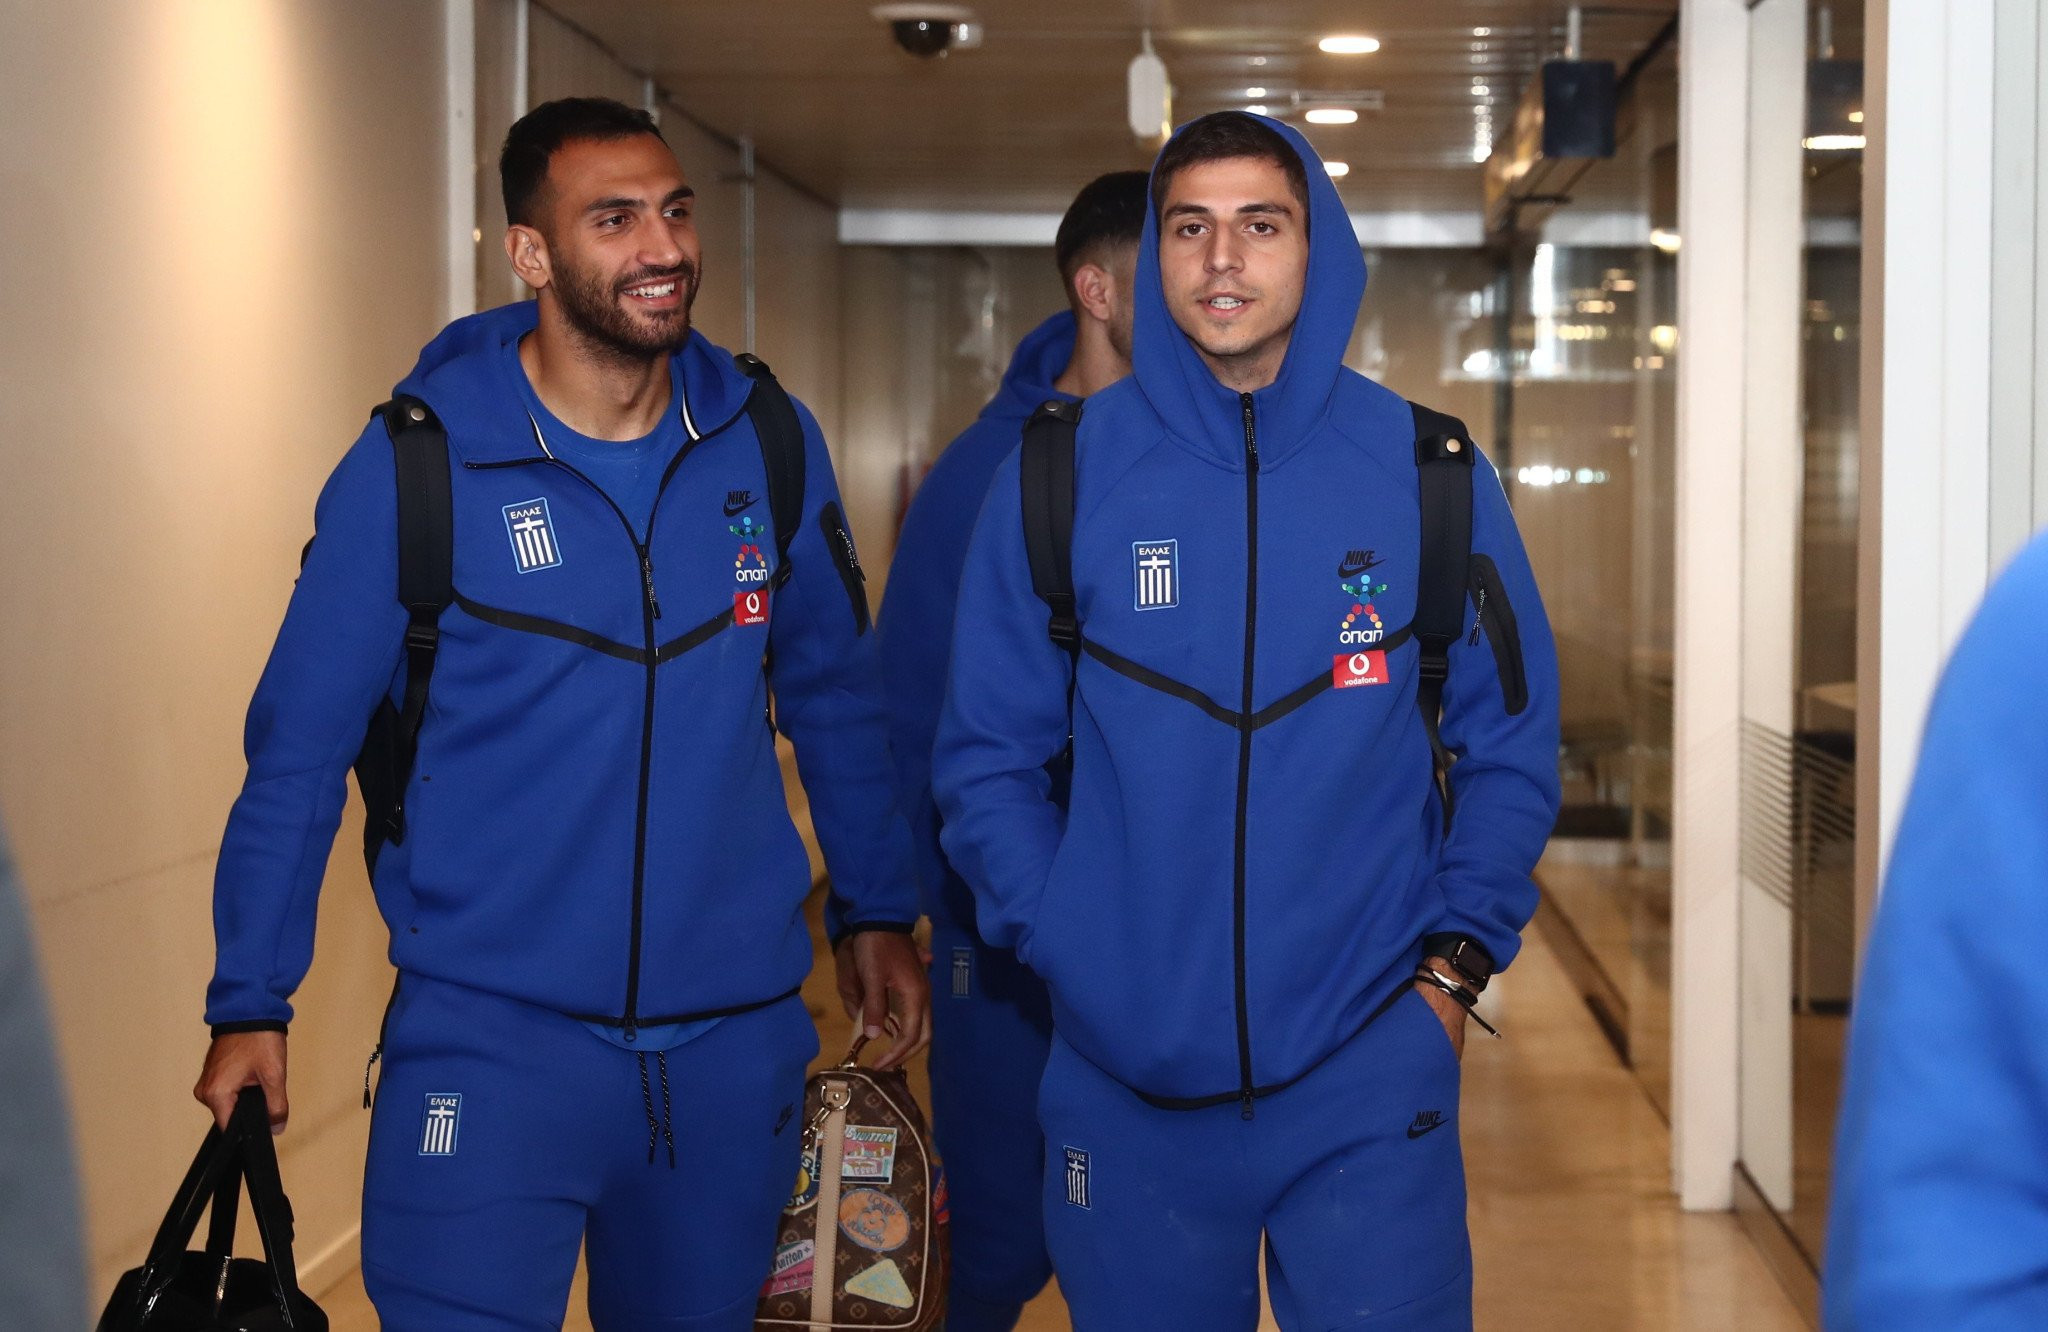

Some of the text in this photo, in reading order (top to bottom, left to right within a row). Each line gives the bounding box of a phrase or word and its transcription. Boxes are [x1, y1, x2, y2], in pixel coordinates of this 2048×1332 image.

[727, 490, 751, 506] NIKE
[510, 506, 542, 519] ΕΛΛΑΣ
[1138, 547, 1170, 556] ΕΛΛΑΣ
[1344, 550, 1375, 566] NIKE
[743, 616, 765, 625] vodafone
[1344, 676, 1379, 687] vodafone
[430, 1097, 458, 1107] ΕΛΛΑΣ
[1413, 1110, 1441, 1127] NIKE
